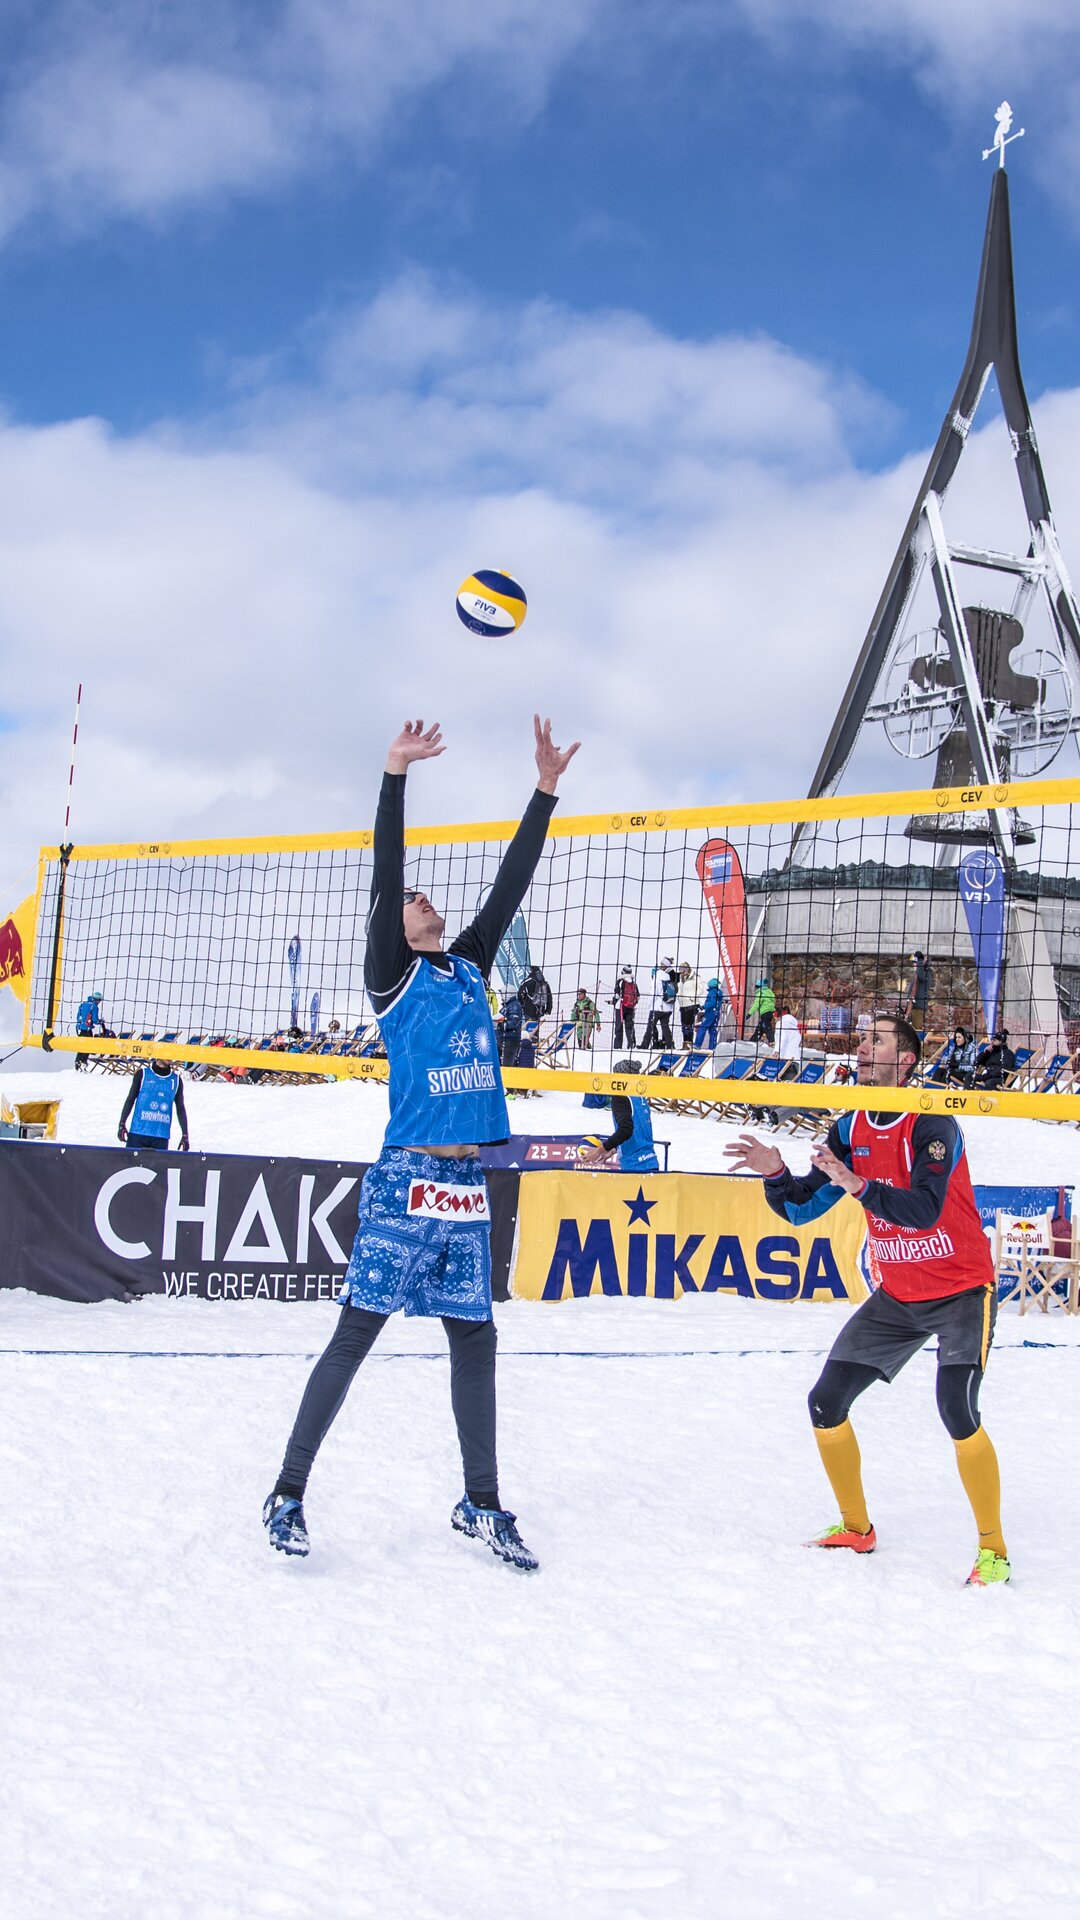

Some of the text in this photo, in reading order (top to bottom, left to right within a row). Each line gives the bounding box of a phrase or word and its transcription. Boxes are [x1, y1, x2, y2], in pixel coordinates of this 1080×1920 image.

[961, 791, 982, 802] CEV
[630, 816, 647, 826] CEV
[361, 1064, 375, 1073] CEV
[611, 1081, 628, 1091] CEV
[944, 1097, 967, 1109] CEV
[531, 1145, 548, 1159] 23
[564, 1146, 577, 1160] 25
[873, 1227, 954, 1261] nowbeach
[162, 1271, 199, 1297] WE
[206, 1272, 298, 1300] CREATE
